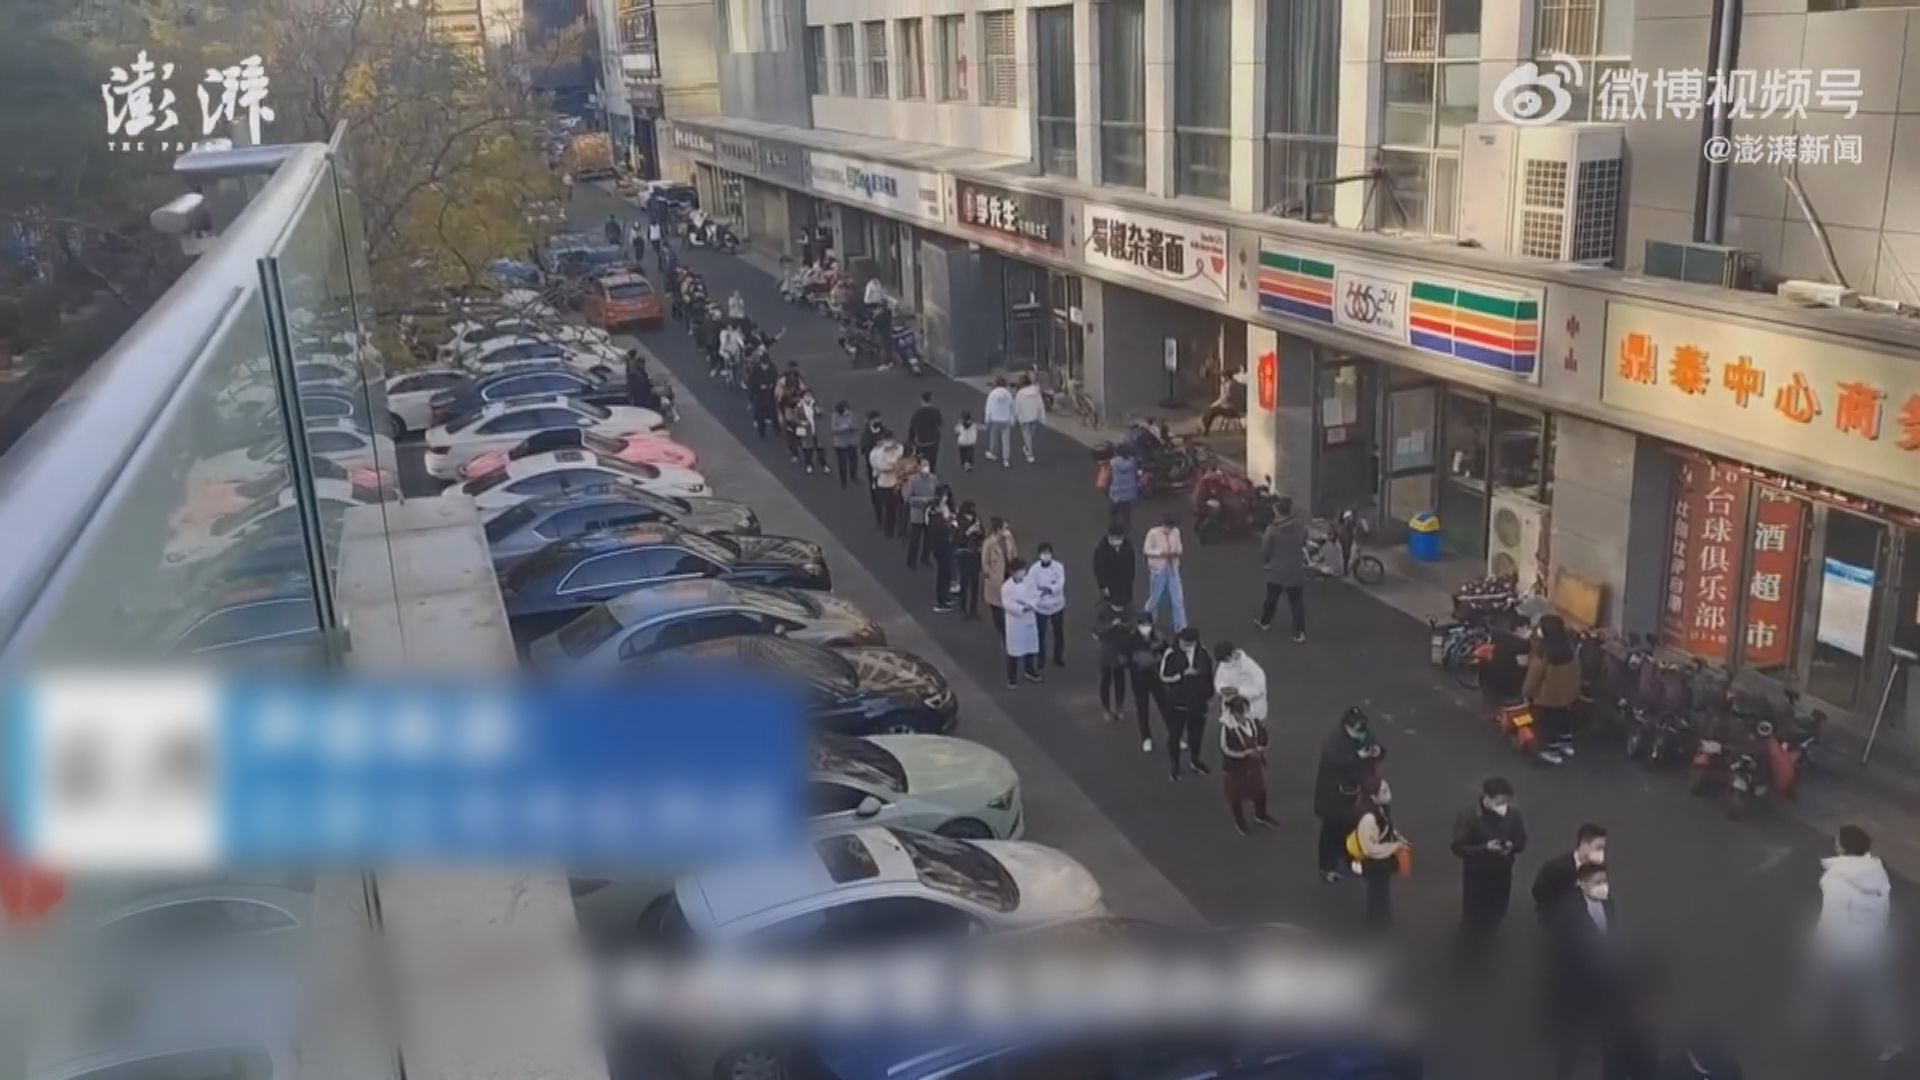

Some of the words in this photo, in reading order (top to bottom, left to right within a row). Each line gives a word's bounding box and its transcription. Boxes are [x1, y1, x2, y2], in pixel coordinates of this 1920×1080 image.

[1092, 216, 1184, 275] 蜀椒杂酱面
[1695, 486, 1735, 629] 台球俱乐部
